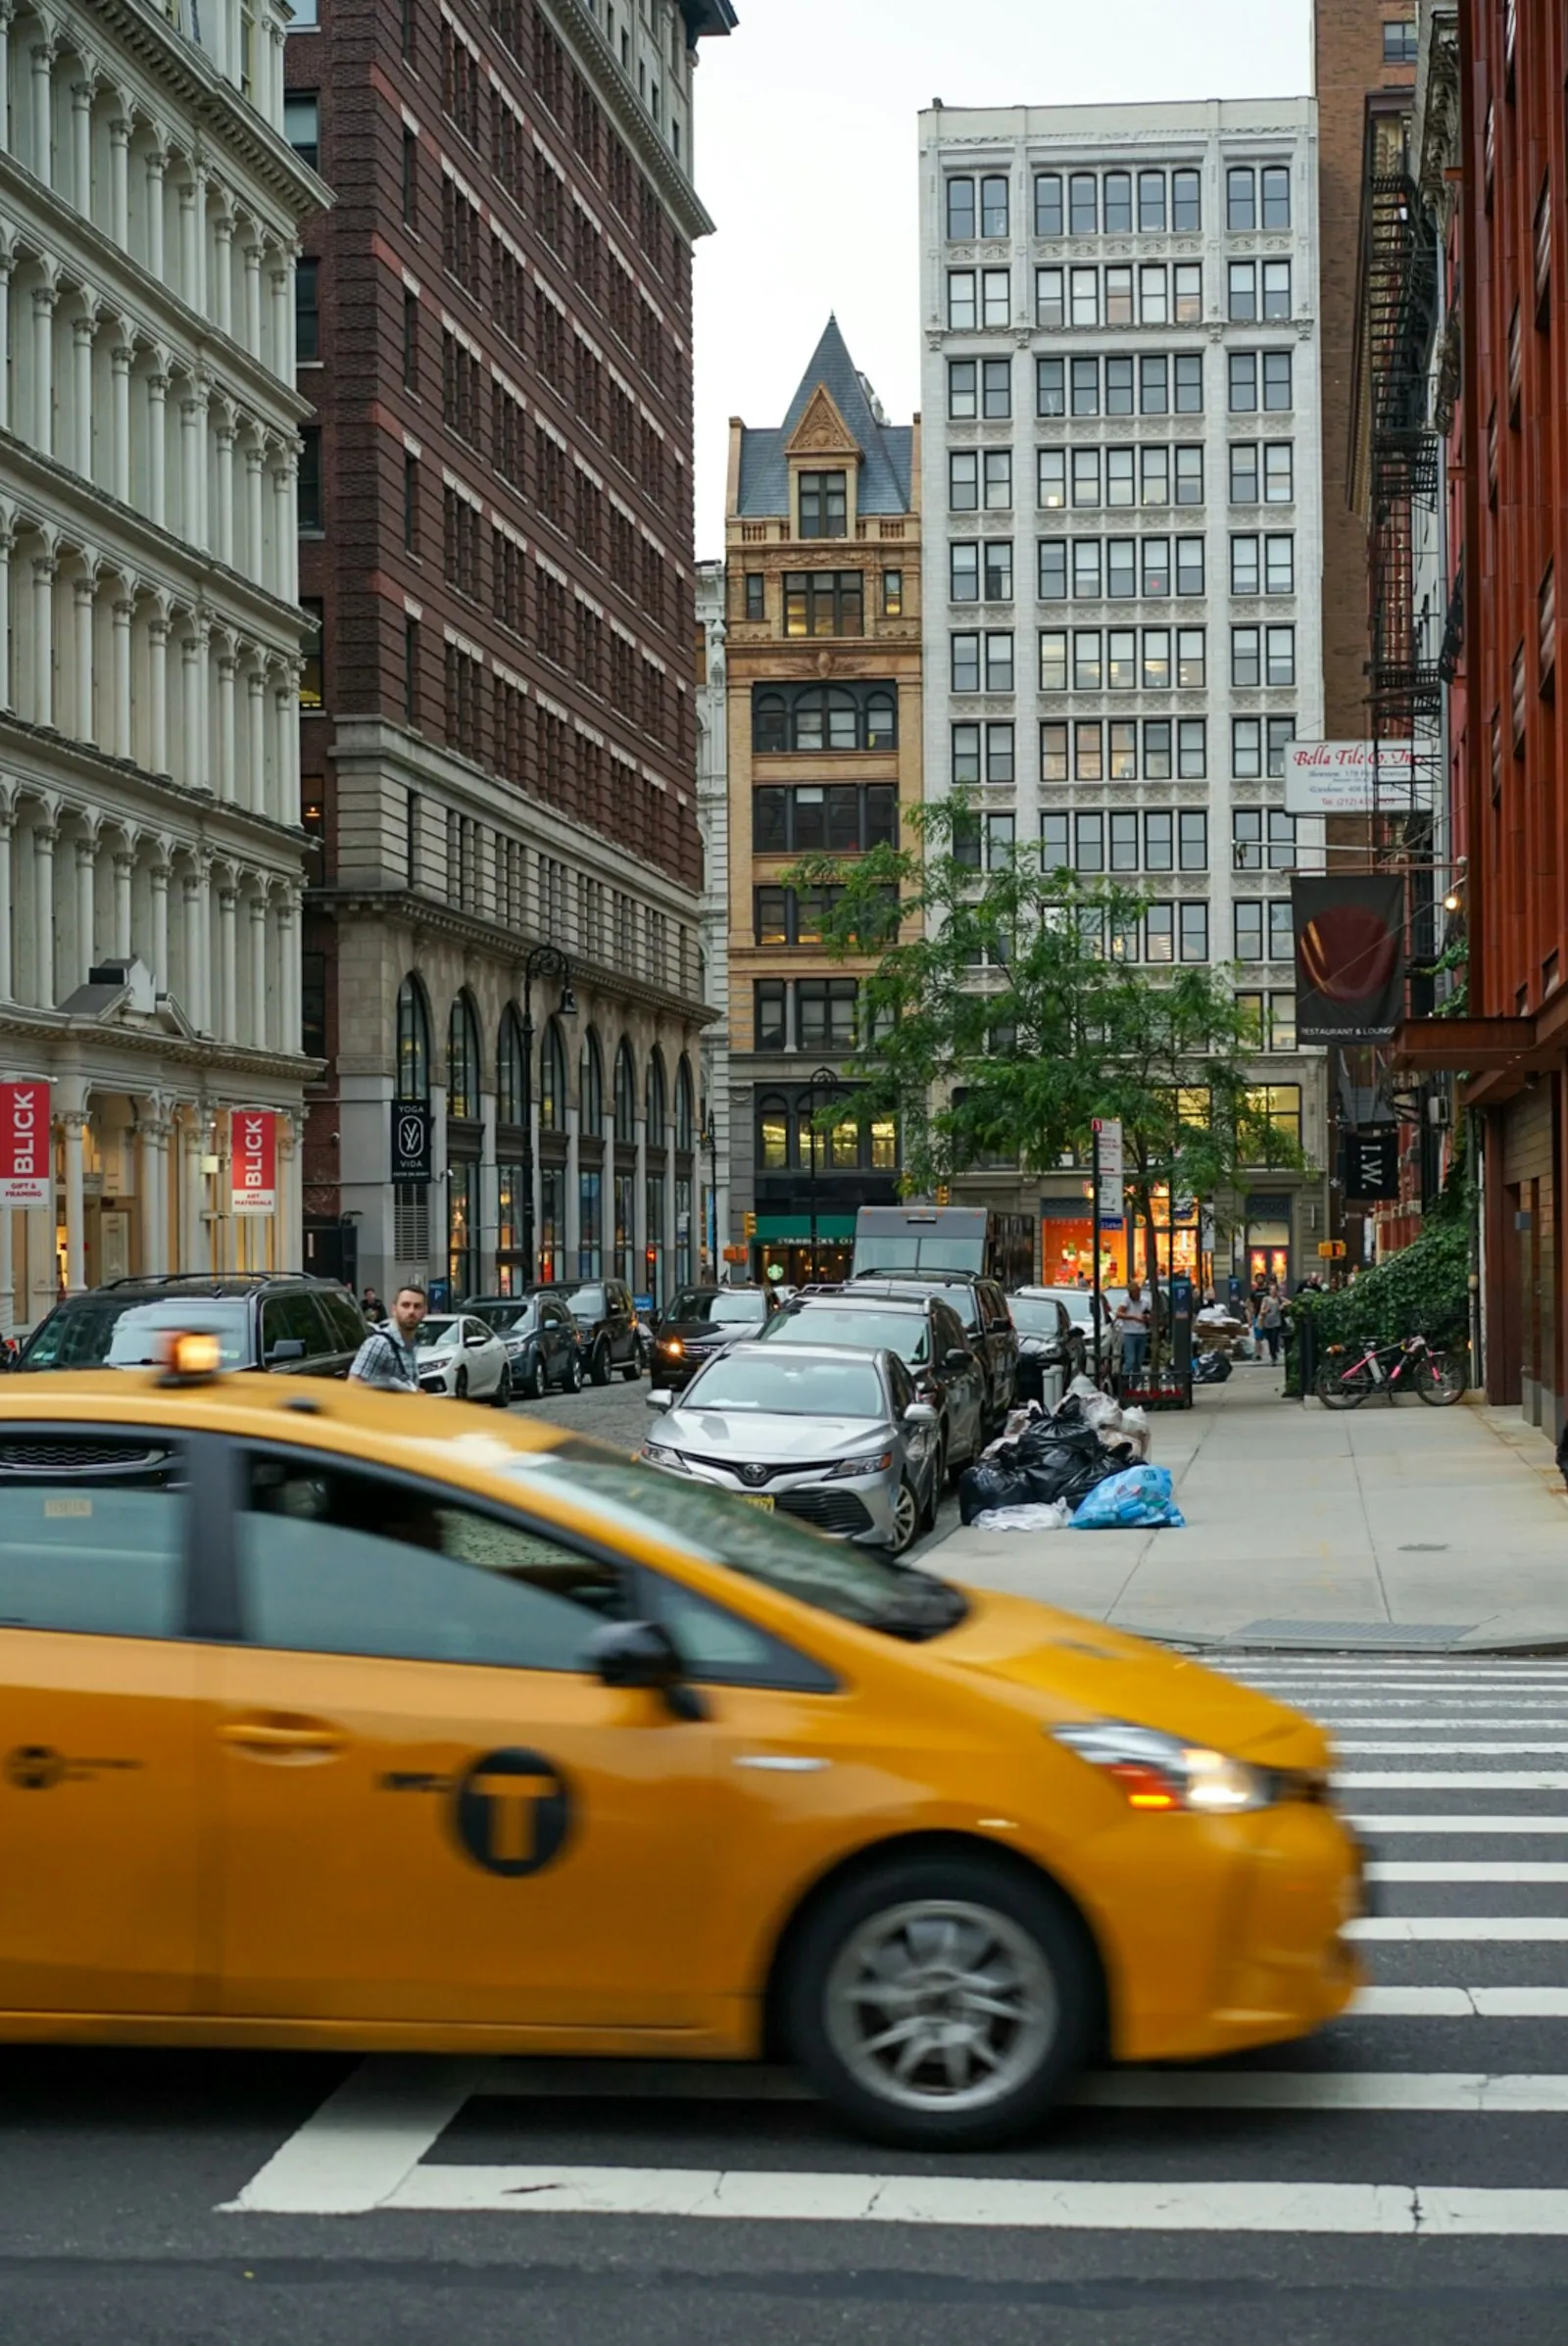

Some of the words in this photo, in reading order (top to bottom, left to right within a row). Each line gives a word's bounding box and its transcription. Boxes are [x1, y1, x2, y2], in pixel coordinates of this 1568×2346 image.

[1293, 744, 1331, 765] Bella
[1335, 744, 1363, 765] Tile
[398, 1104, 424, 1113] YOGA
[13, 1090, 34, 1175] BLICK
[245, 1117, 263, 1187] BLICK
[399, 1159, 423, 1168] VIDA
